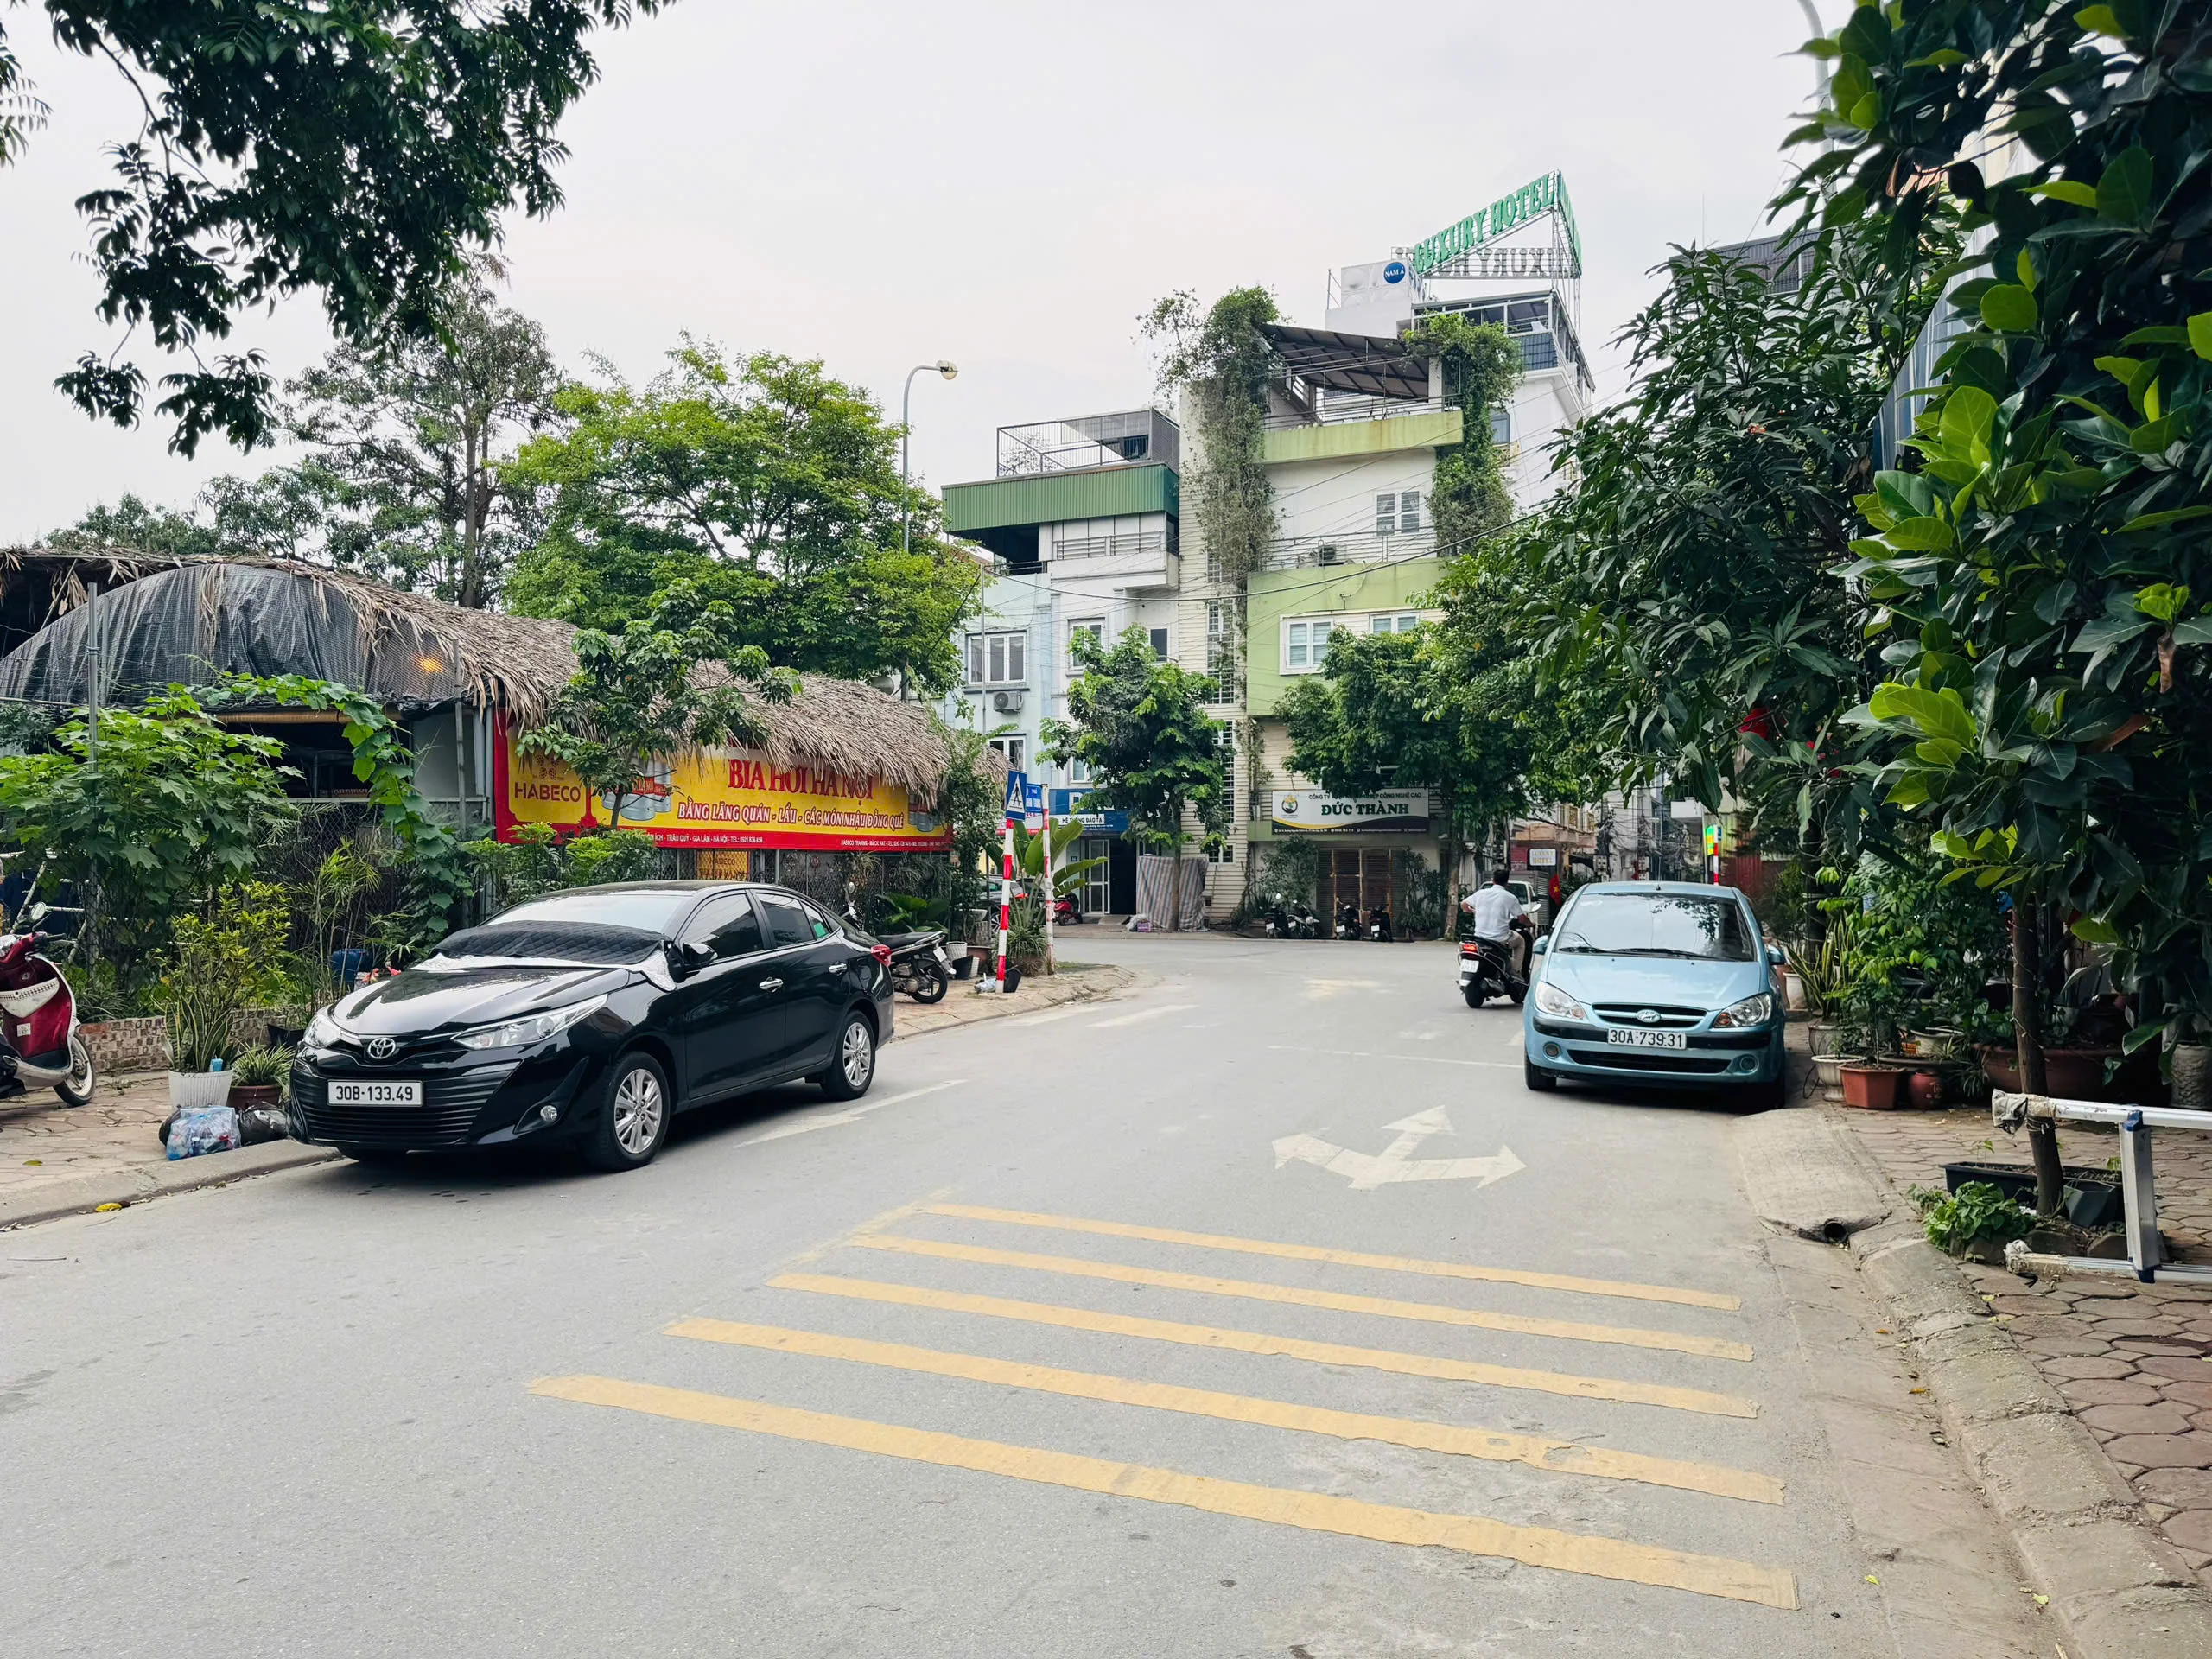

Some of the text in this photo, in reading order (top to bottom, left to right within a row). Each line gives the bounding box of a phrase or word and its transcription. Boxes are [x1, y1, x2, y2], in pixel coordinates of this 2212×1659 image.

[1414, 209, 1487, 273] LUXURY
[1490, 174, 1554, 235] HOTEL
[1385, 269, 1399, 277] NAM
[728, 759, 766, 791] BIA
[514, 782, 581, 803] HABECO
[711, 801, 740, 822] LĂNG
[741, 803, 771, 825] QUÁN
[778, 802, 797, 823] LẨU
[804, 806, 822, 825] CÁC
[823, 808, 842, 827] MÓN
[843, 810, 867, 830] NHẬU
[867, 809, 888, 829] ĐỒNG
[889, 812, 904, 831] QUÊ
[1321, 800, 1409, 816] ĐỨC THÀNH
[335, 1086, 413, 1101] 30B-133.49
